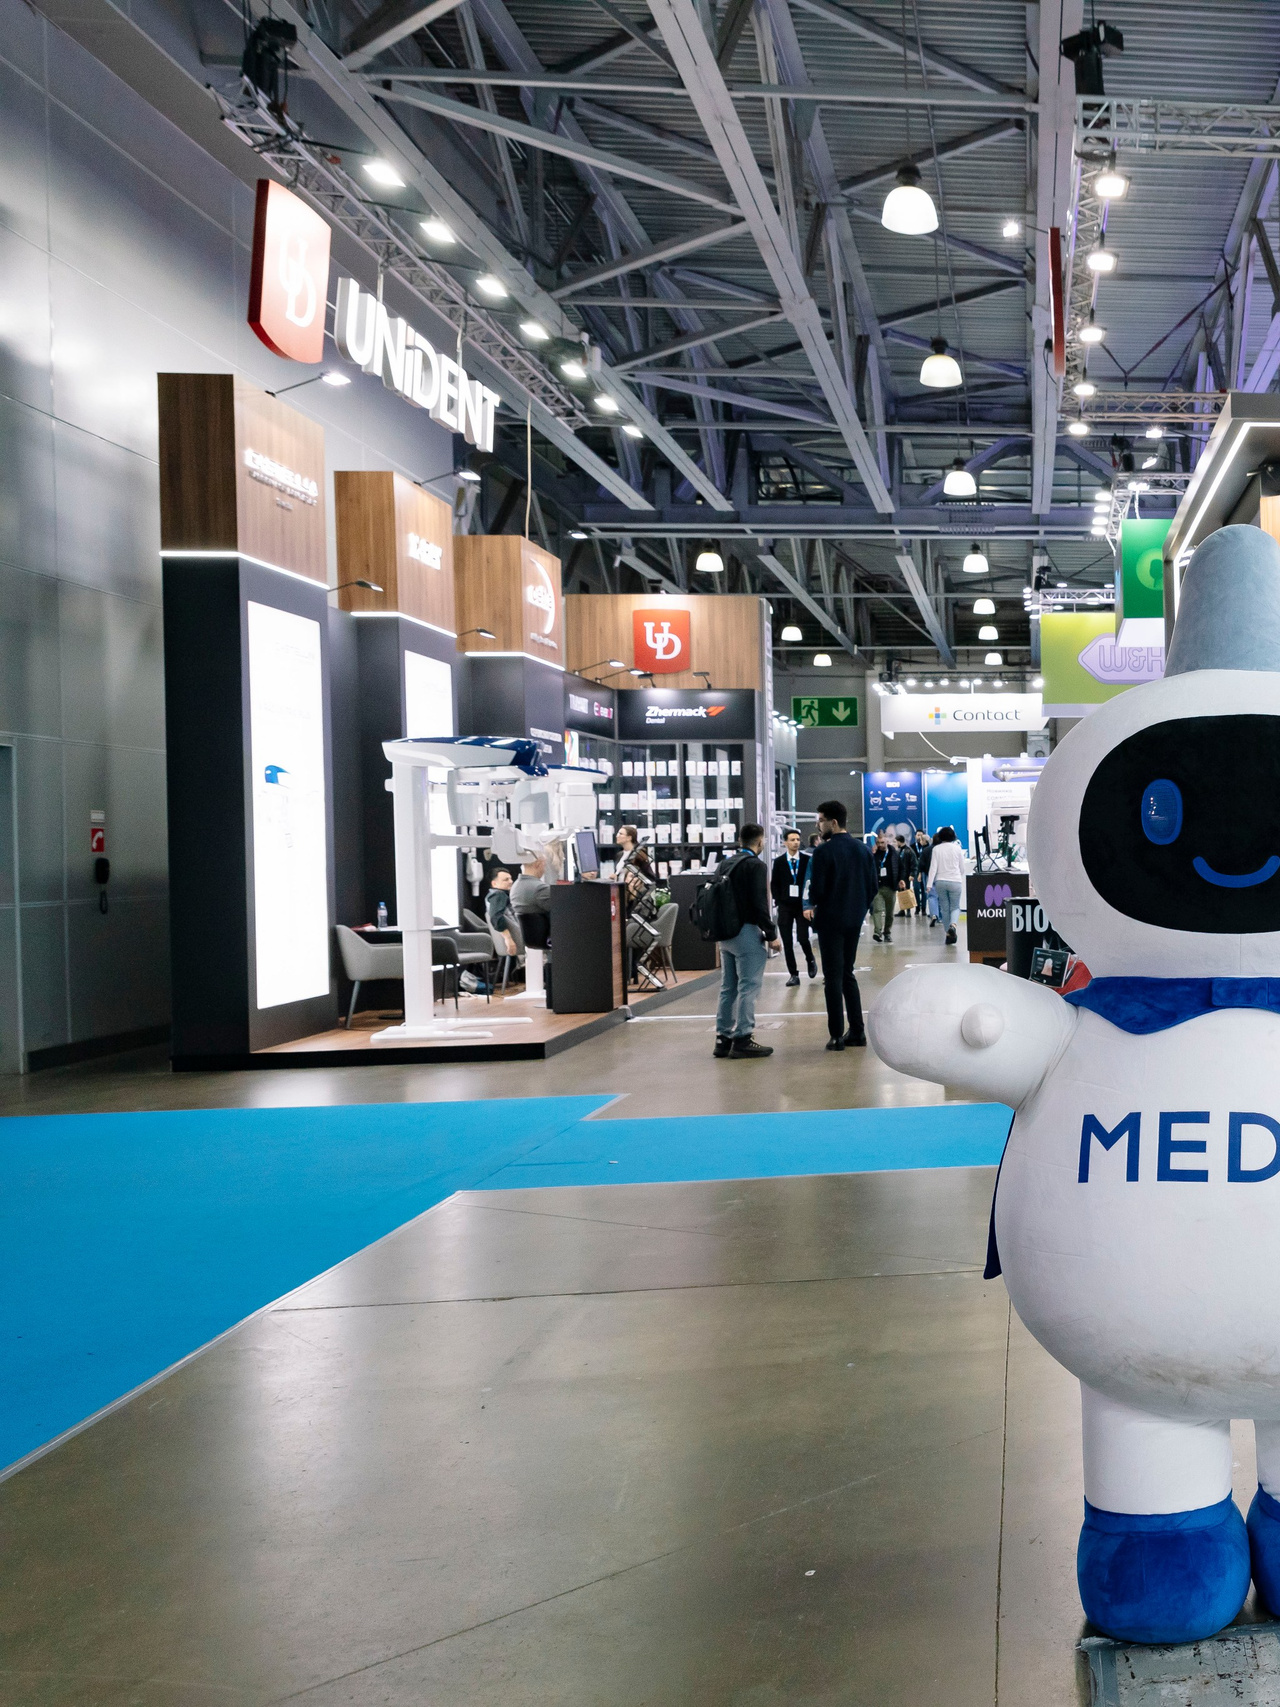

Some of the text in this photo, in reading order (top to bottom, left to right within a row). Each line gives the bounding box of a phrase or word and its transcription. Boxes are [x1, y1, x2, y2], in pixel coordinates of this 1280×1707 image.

[645, 706, 707, 718] Zhermack
[953, 709, 1021, 721] Contact
[1012, 904, 1056, 933] BIO
